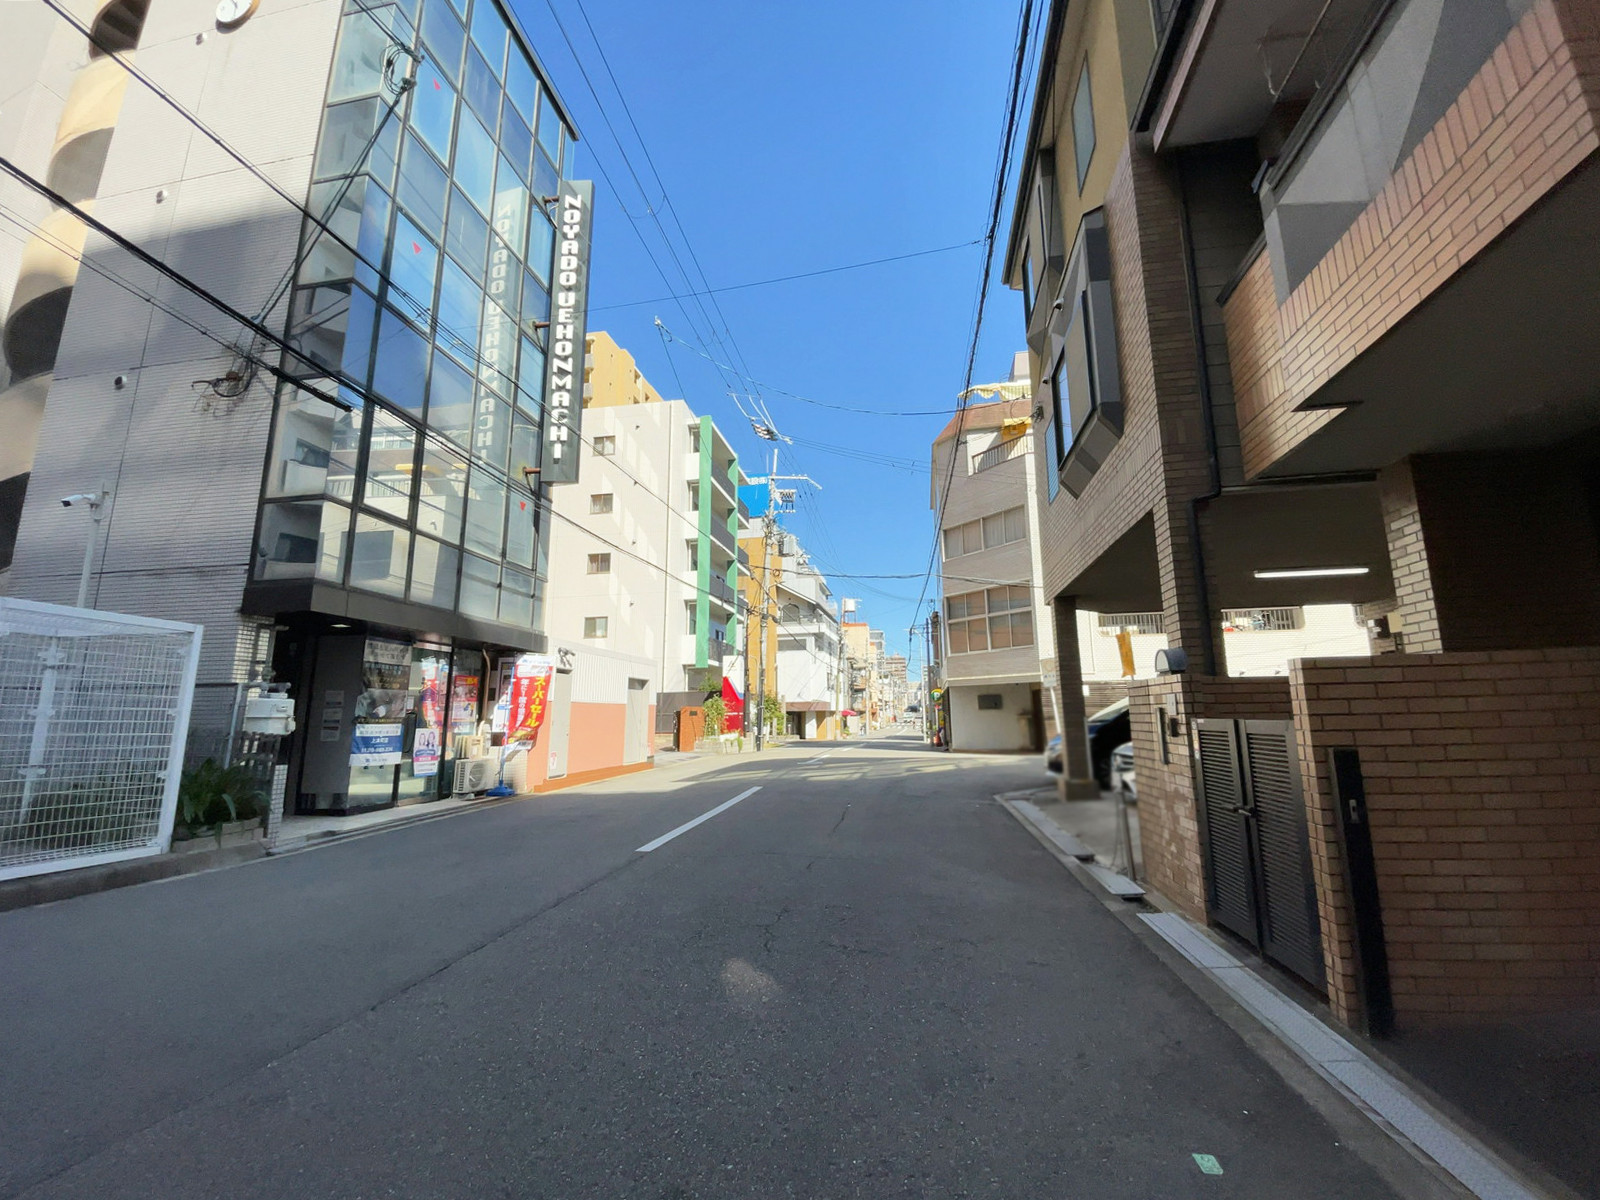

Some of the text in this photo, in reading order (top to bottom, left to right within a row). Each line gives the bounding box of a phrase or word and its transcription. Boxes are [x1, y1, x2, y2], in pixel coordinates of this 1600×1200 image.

[550, 194, 581, 459] NOYADO UEHONMACHI
[524, 676, 546, 727] スーパーセール
